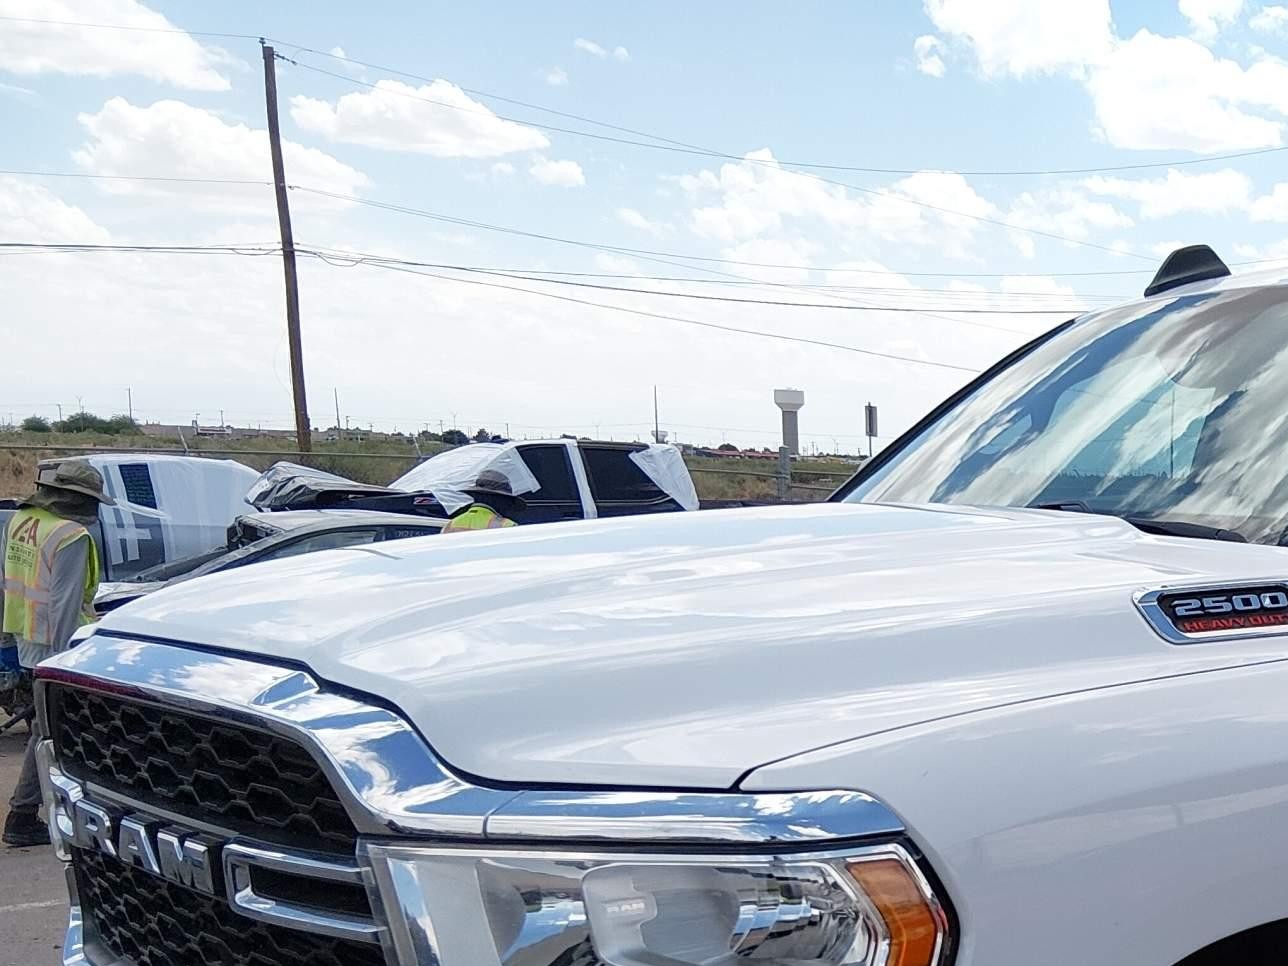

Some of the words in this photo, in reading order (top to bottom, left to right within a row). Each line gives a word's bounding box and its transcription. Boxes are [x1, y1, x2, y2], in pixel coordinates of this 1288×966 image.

[1171, 591, 1288, 617] 2500
[1183, 615, 1247, 633] HEAVY
[74, 798, 215, 895] RAM
